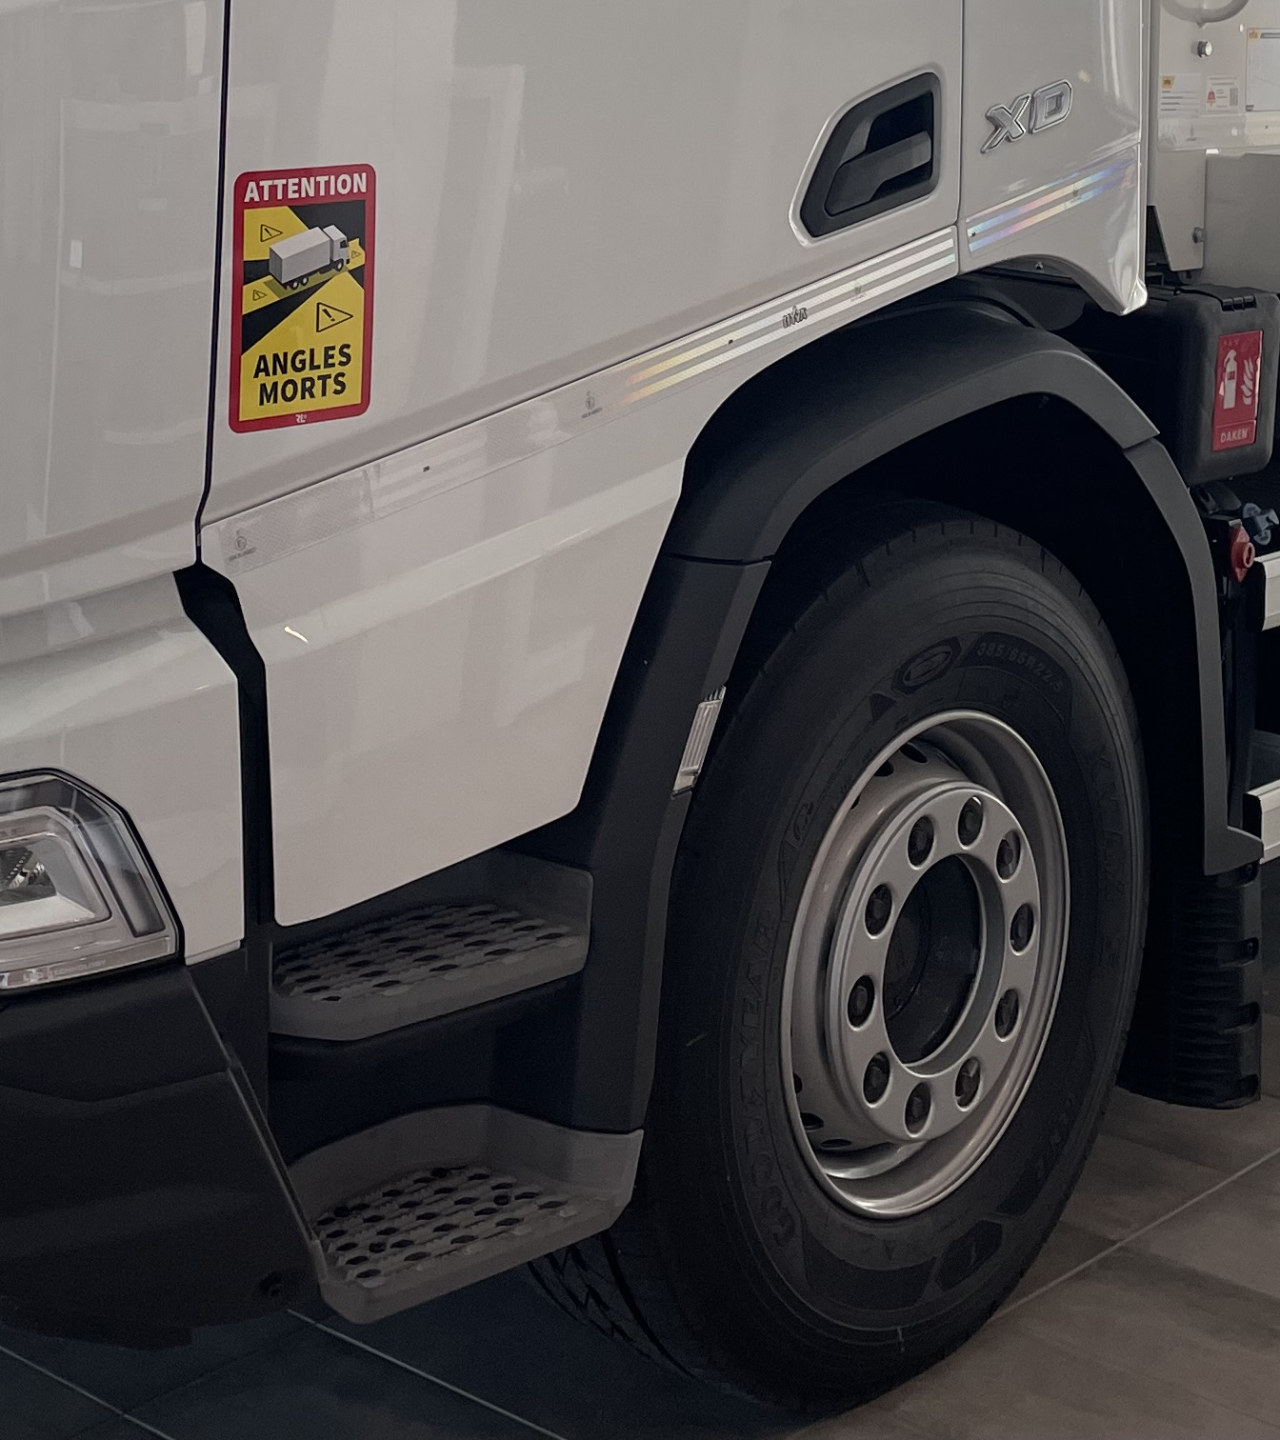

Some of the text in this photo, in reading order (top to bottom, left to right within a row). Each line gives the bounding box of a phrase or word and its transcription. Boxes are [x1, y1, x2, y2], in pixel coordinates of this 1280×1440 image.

[980, 79, 1073, 154] XD
[244, 172, 367, 203] ATTENTION
[253, 343, 352, 379] ANGLES
[259, 371, 347, 407] MORTS
[1221, 428, 1249, 444] DAKEN
